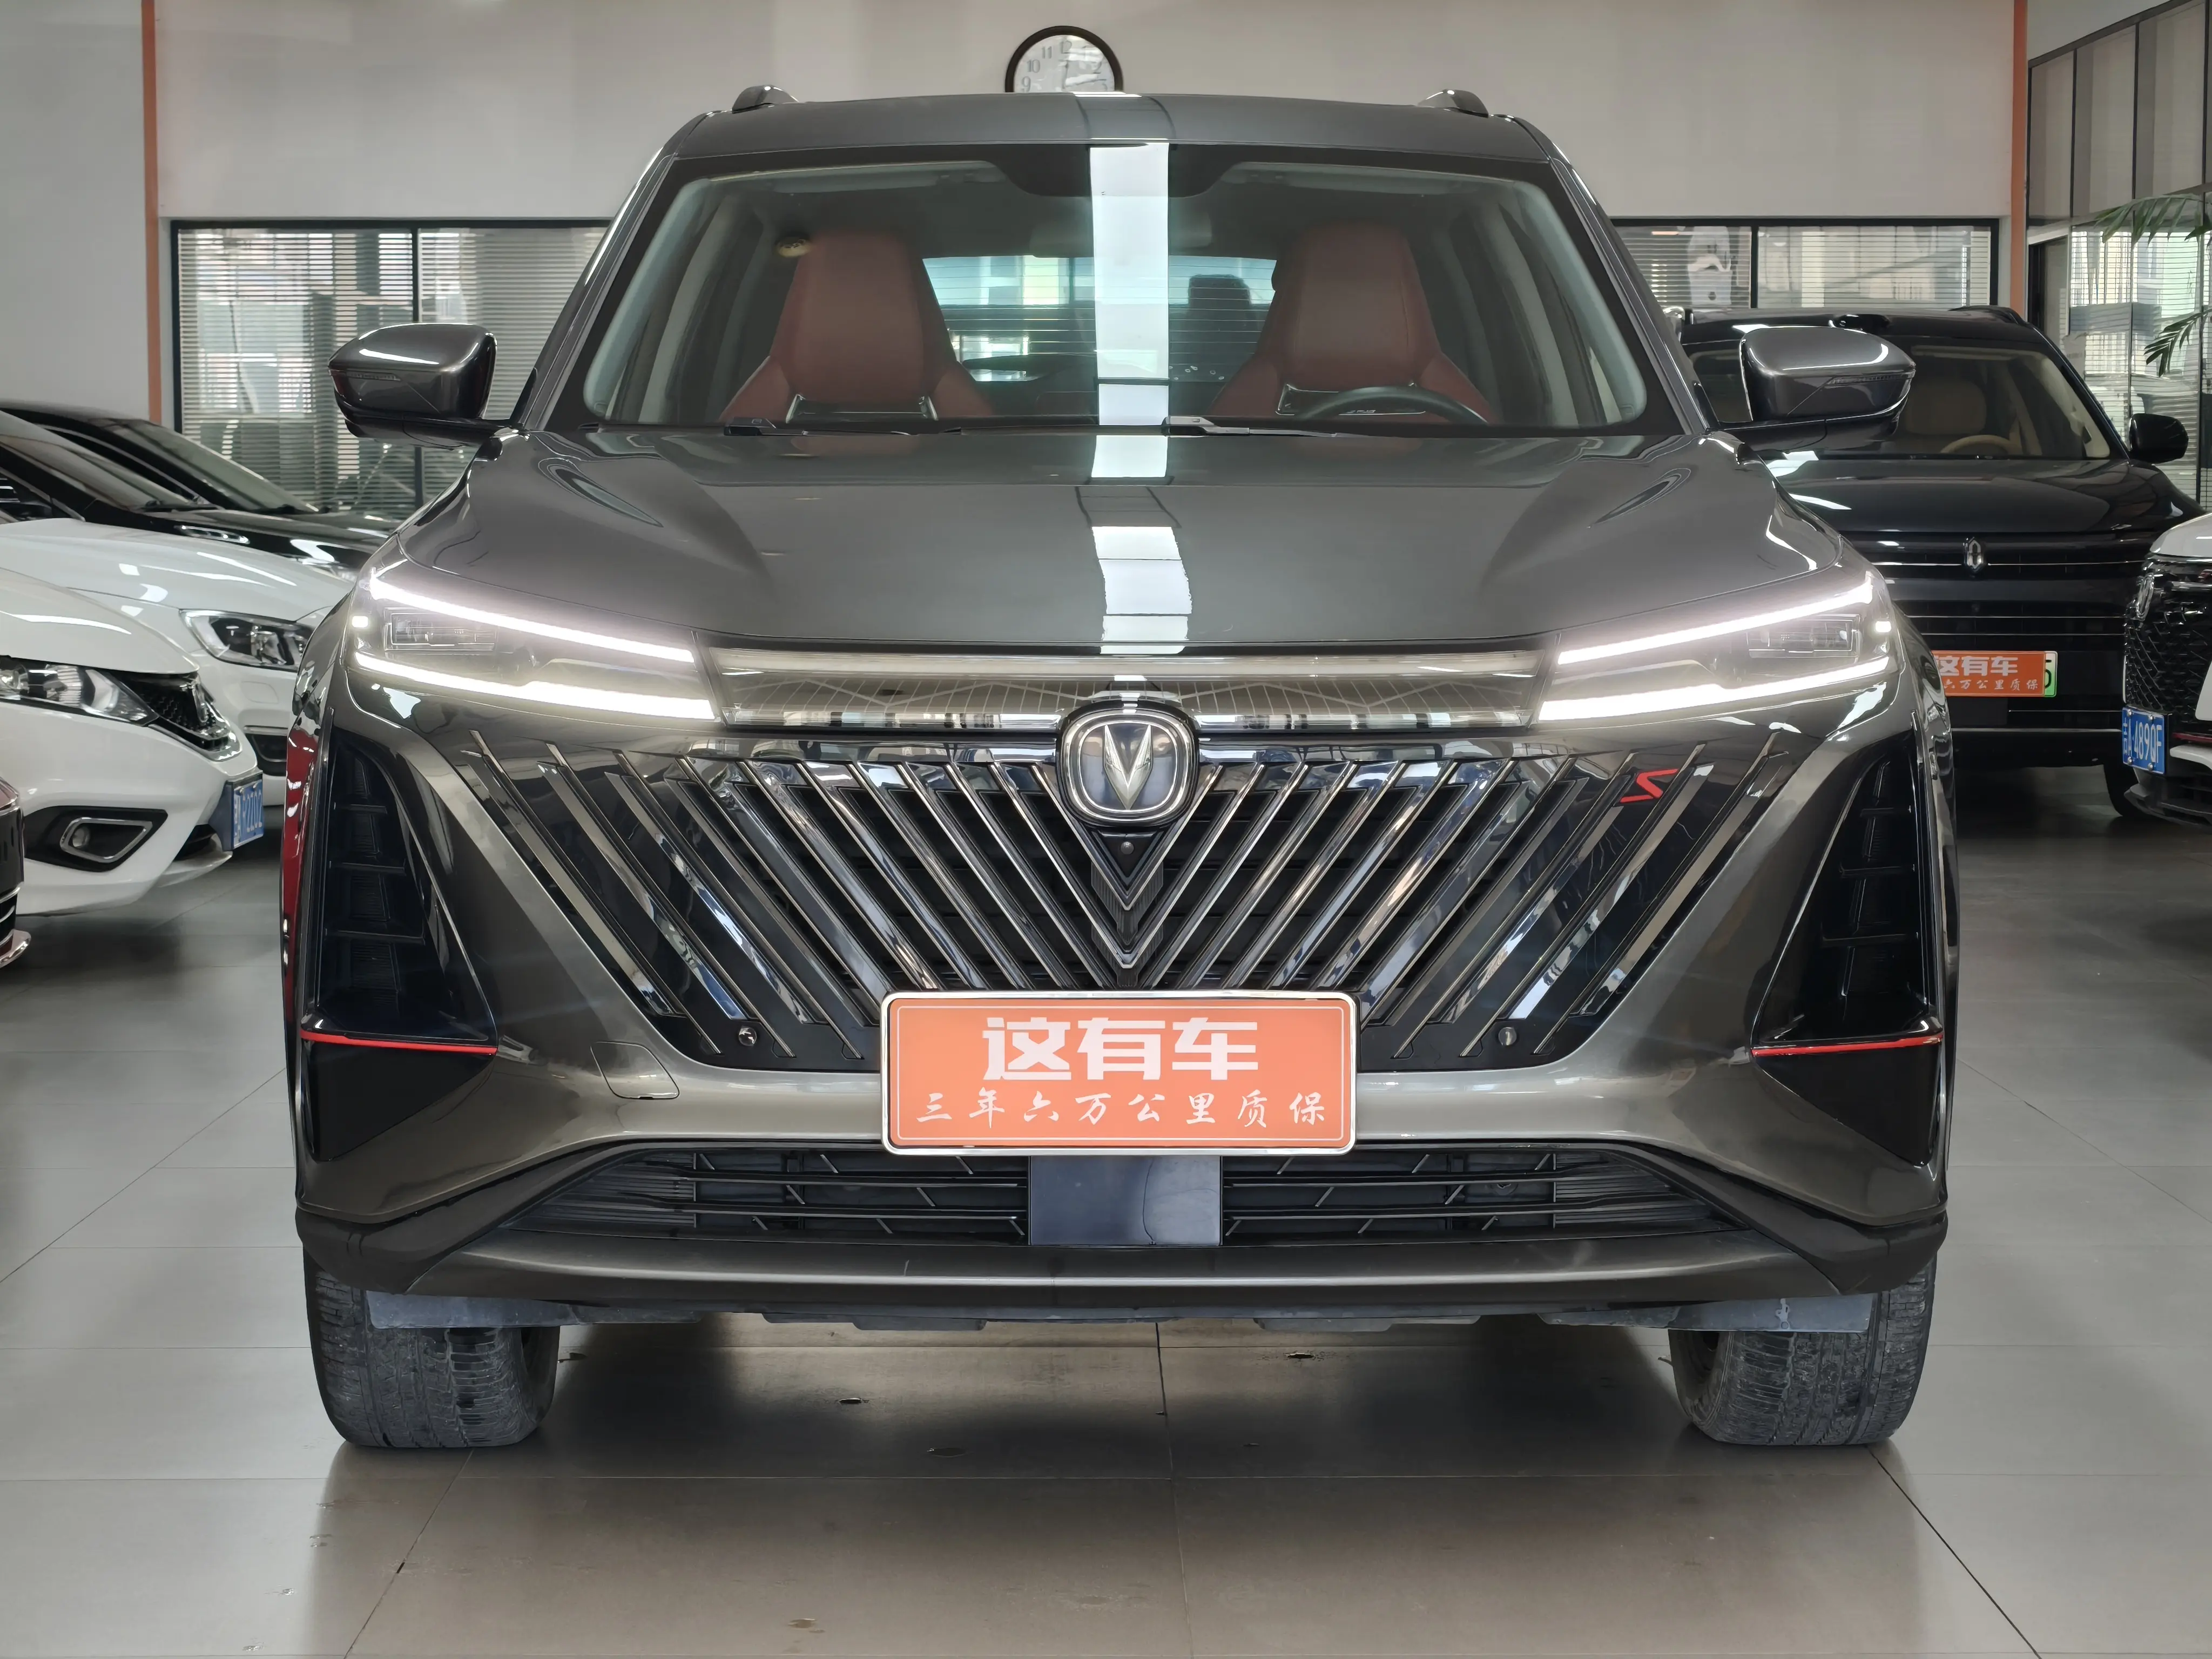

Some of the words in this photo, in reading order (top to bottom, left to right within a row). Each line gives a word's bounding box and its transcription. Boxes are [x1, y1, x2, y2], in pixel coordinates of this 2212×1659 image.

[1041, 46, 1053, 59] 11
[1058, 41, 1073, 54] 12
[1027, 59, 1041, 73] 10
[1021, 76, 1031, 92] 9
[982, 1017, 1259, 1081] 这有车
[916, 1087, 1326, 1128] 三年六万公里质保
